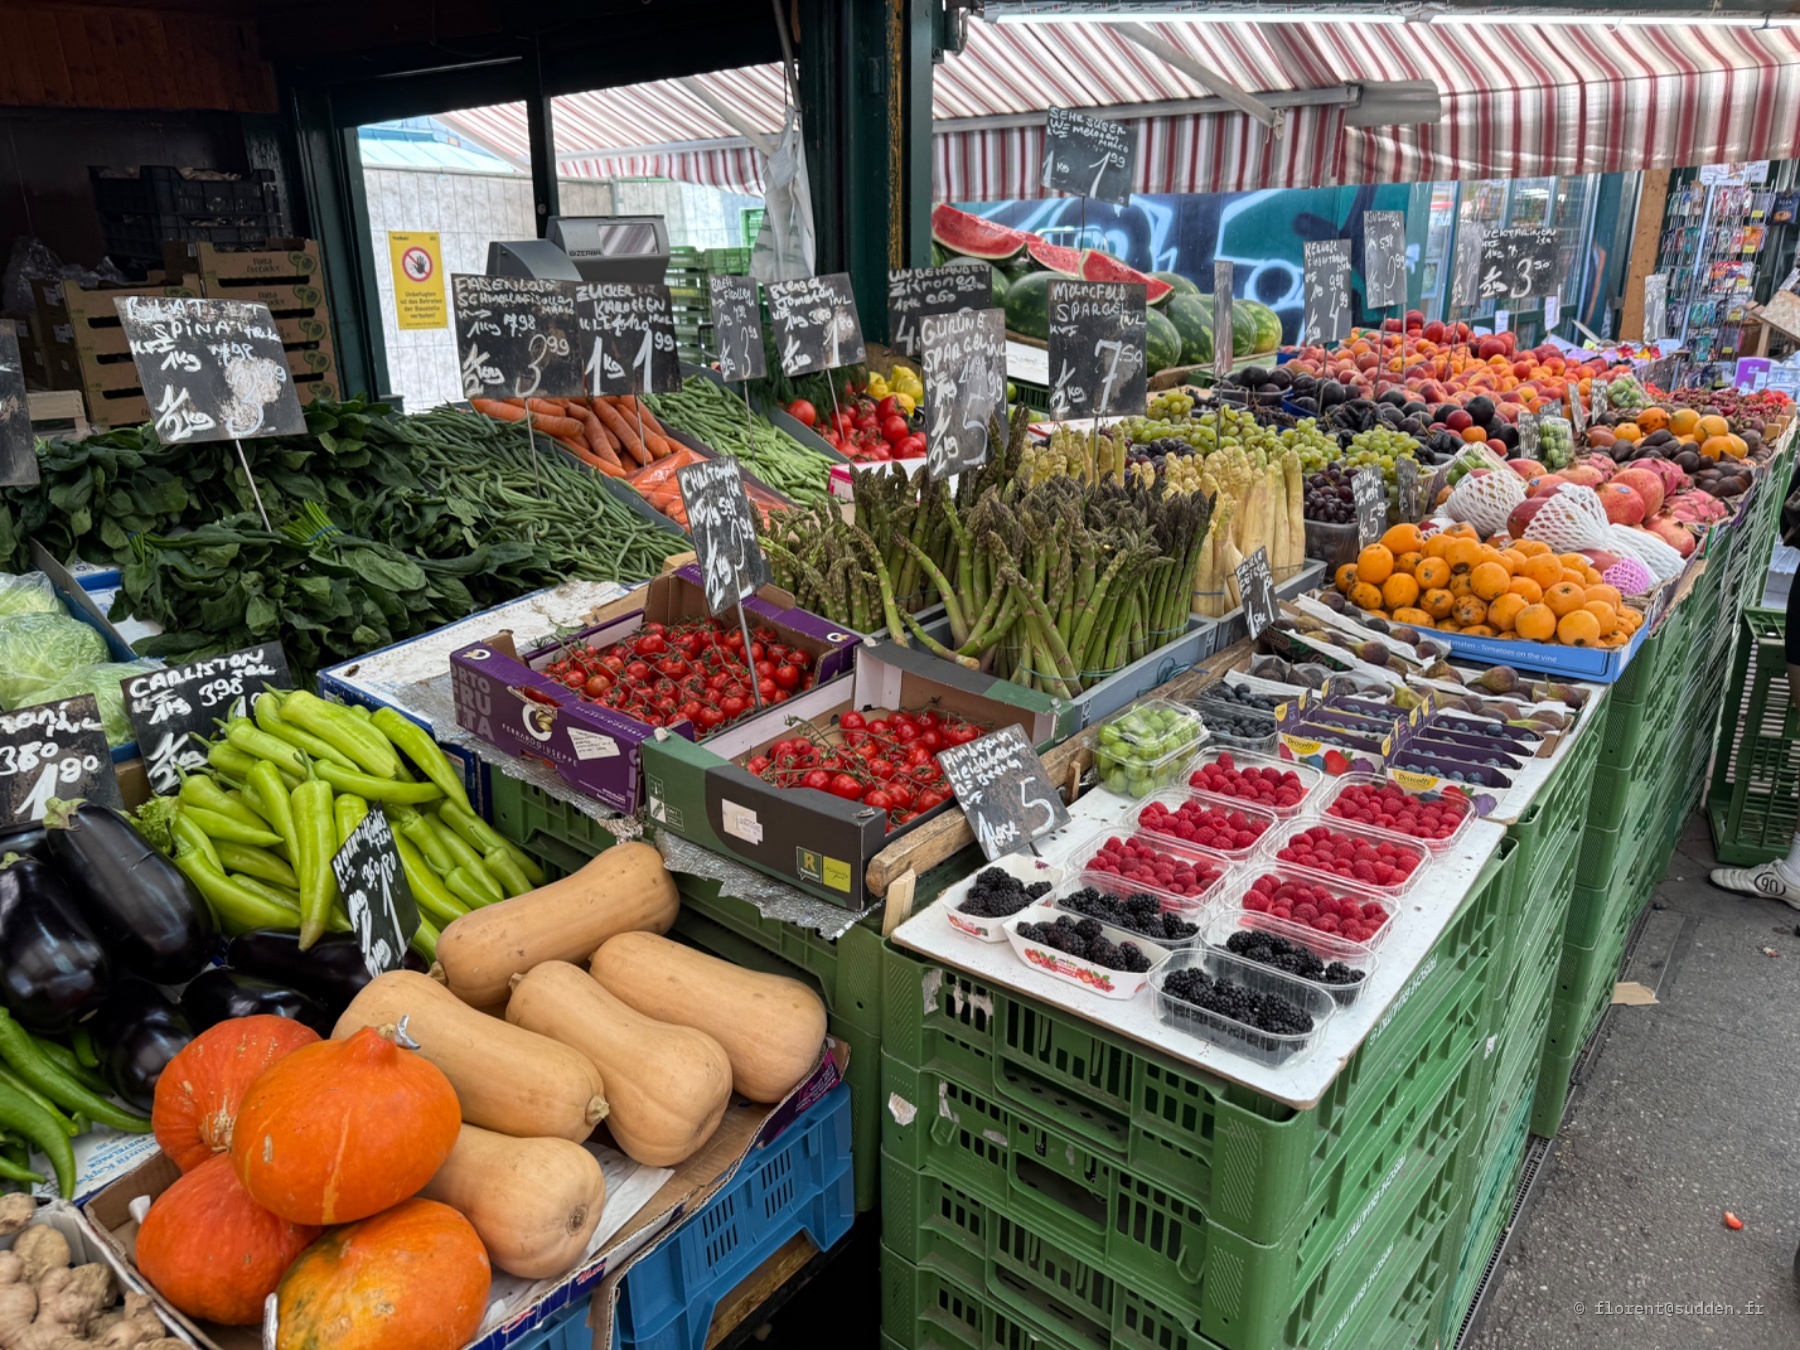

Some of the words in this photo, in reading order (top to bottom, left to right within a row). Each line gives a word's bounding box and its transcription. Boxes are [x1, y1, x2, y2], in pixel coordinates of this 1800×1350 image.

[1516, 650, 1526, 658] on
[1528, 651, 1539, 660] the
[1020, 776, 1055, 837] 5
[804, 852, 818, 873] R
[1761, 877, 1778, 893] 90
